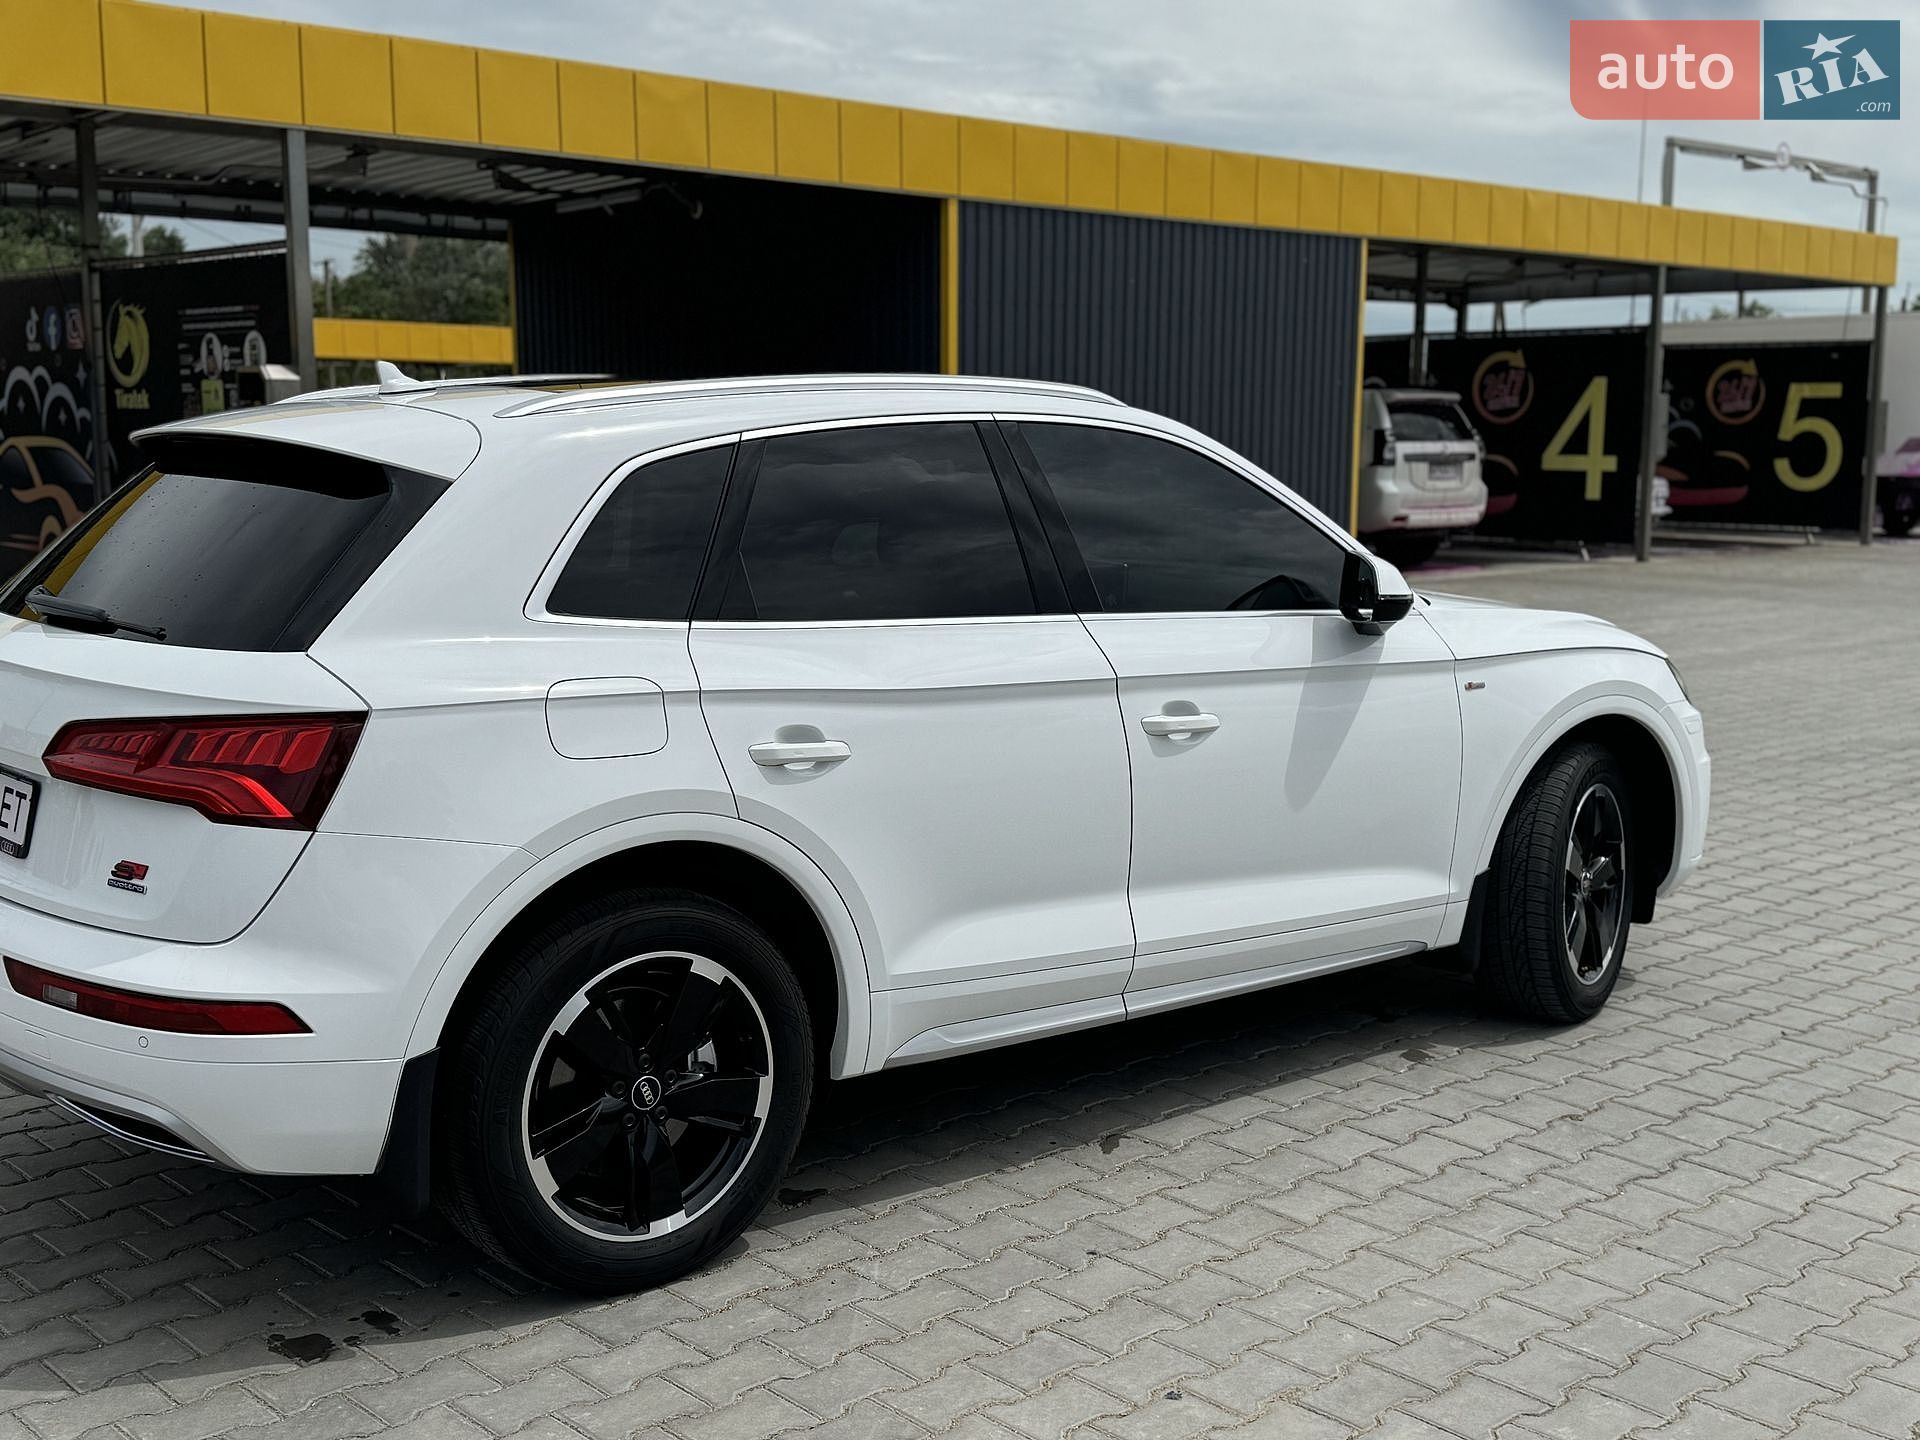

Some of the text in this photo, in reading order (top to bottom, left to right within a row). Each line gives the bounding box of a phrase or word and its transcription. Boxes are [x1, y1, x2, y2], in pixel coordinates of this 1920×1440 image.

[1541, 375, 1618, 501] 4
[1773, 381, 1845, 493] 5
[0, 786, 27, 832] ET
